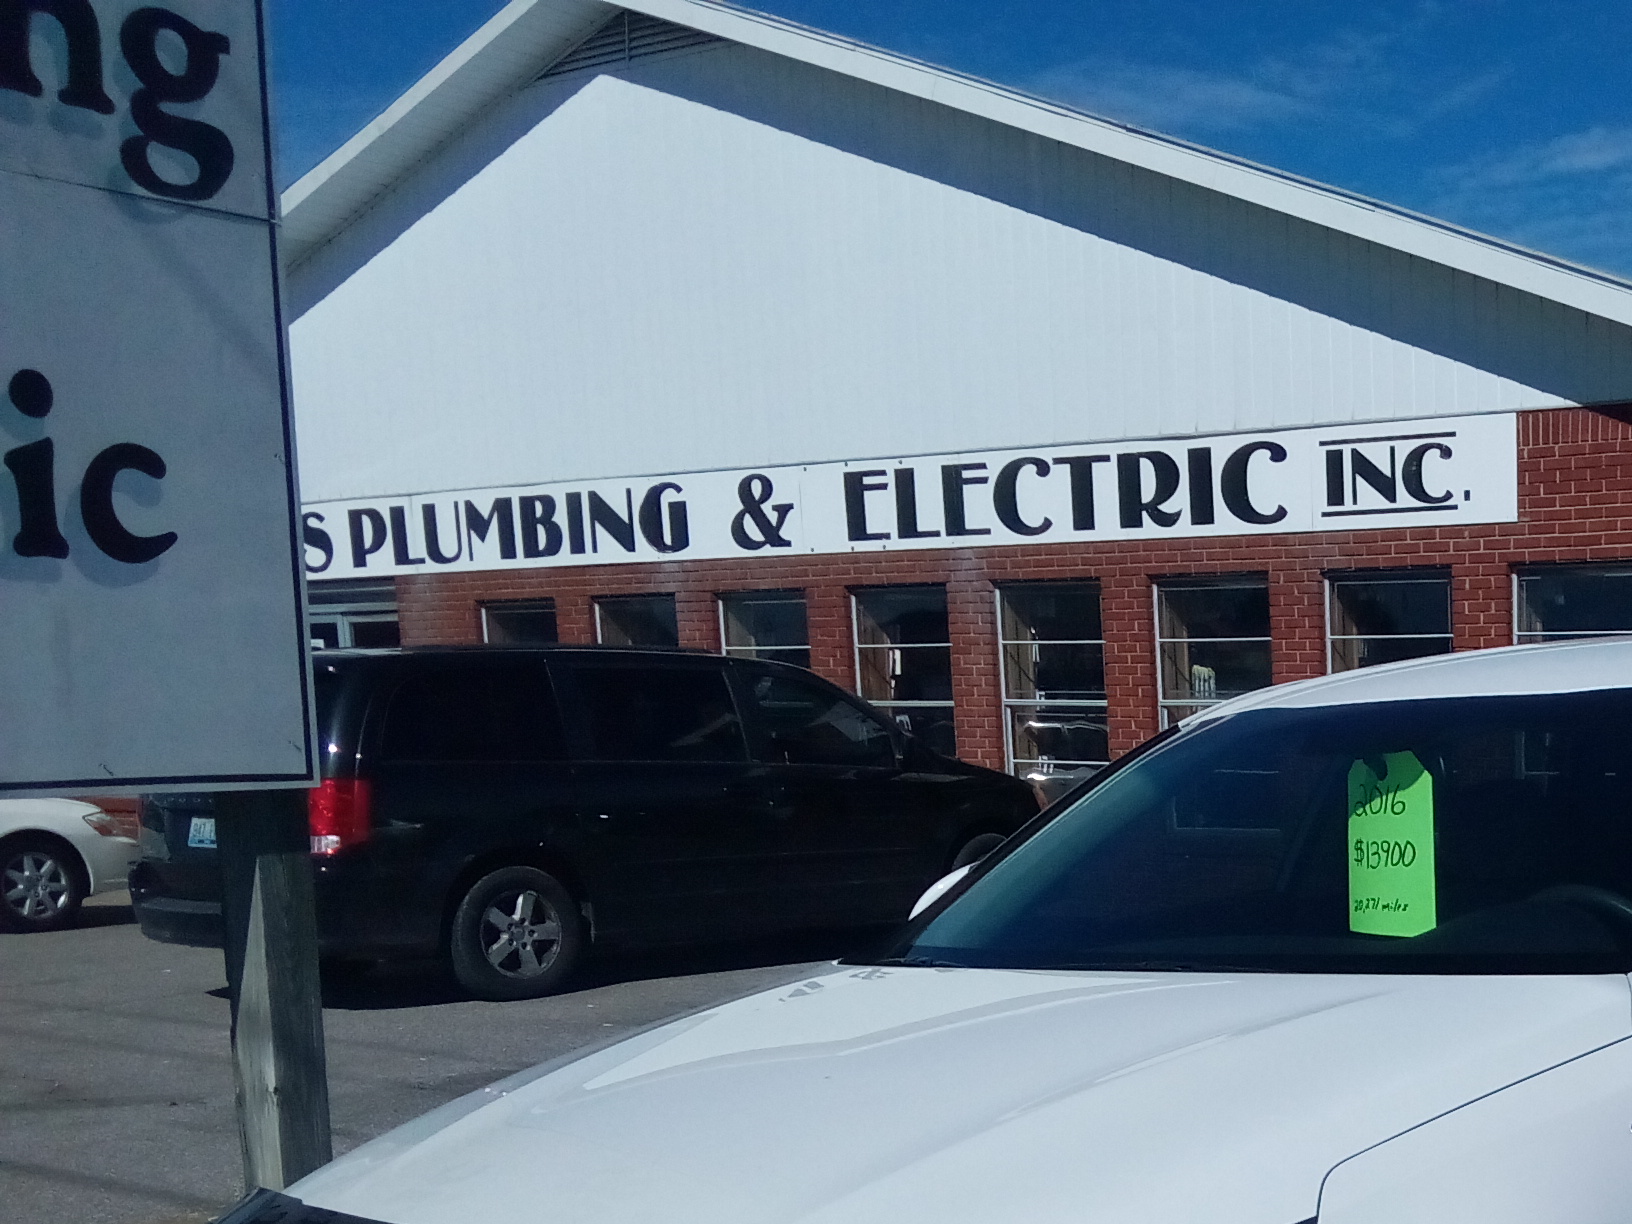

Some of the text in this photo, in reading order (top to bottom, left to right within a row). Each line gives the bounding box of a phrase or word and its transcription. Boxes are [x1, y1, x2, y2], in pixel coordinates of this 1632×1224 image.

[347, 481, 691, 568] PLUMBING
[730, 473, 794, 550] &
[843, 440, 1288, 541] ELECTRIC
[1322, 441, 1472, 506] INC.
[1354, 783, 1406, 817] 2016
[1353, 837, 1417, 870] $13900
